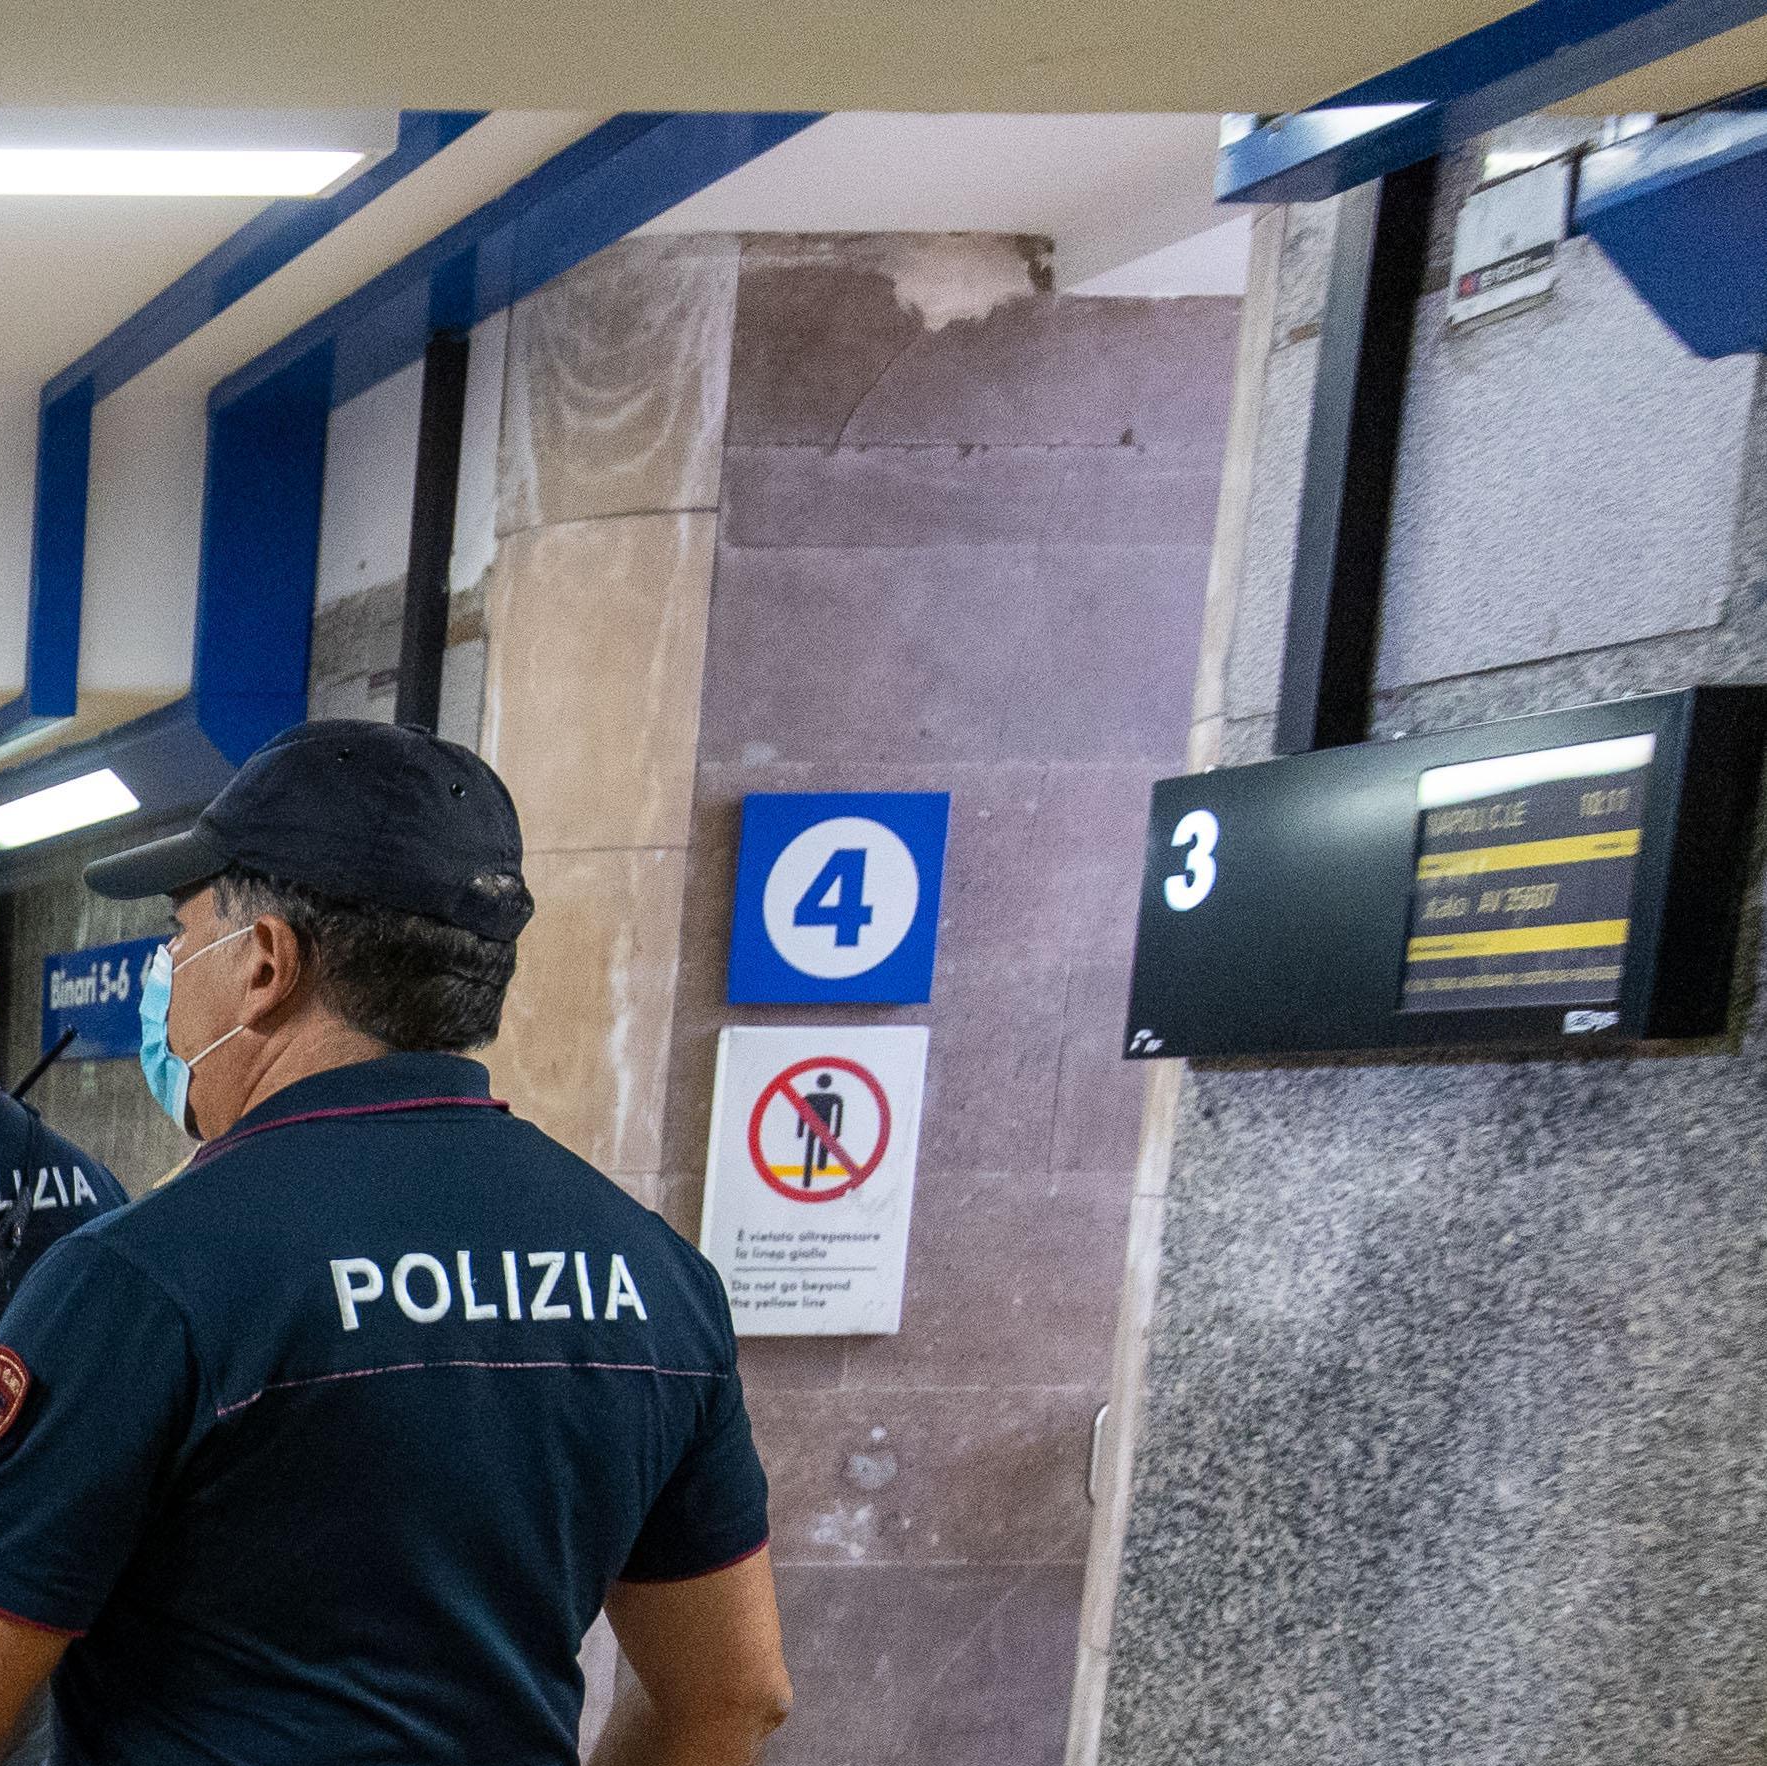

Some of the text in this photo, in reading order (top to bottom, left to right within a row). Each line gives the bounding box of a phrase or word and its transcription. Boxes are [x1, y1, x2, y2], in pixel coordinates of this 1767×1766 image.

[793, 848, 873, 948] 4
[1164, 809, 1219, 912] 3
[50, 958, 129, 1010] Binari 5-6
[330, 1249, 648, 1331] POLIZIA
